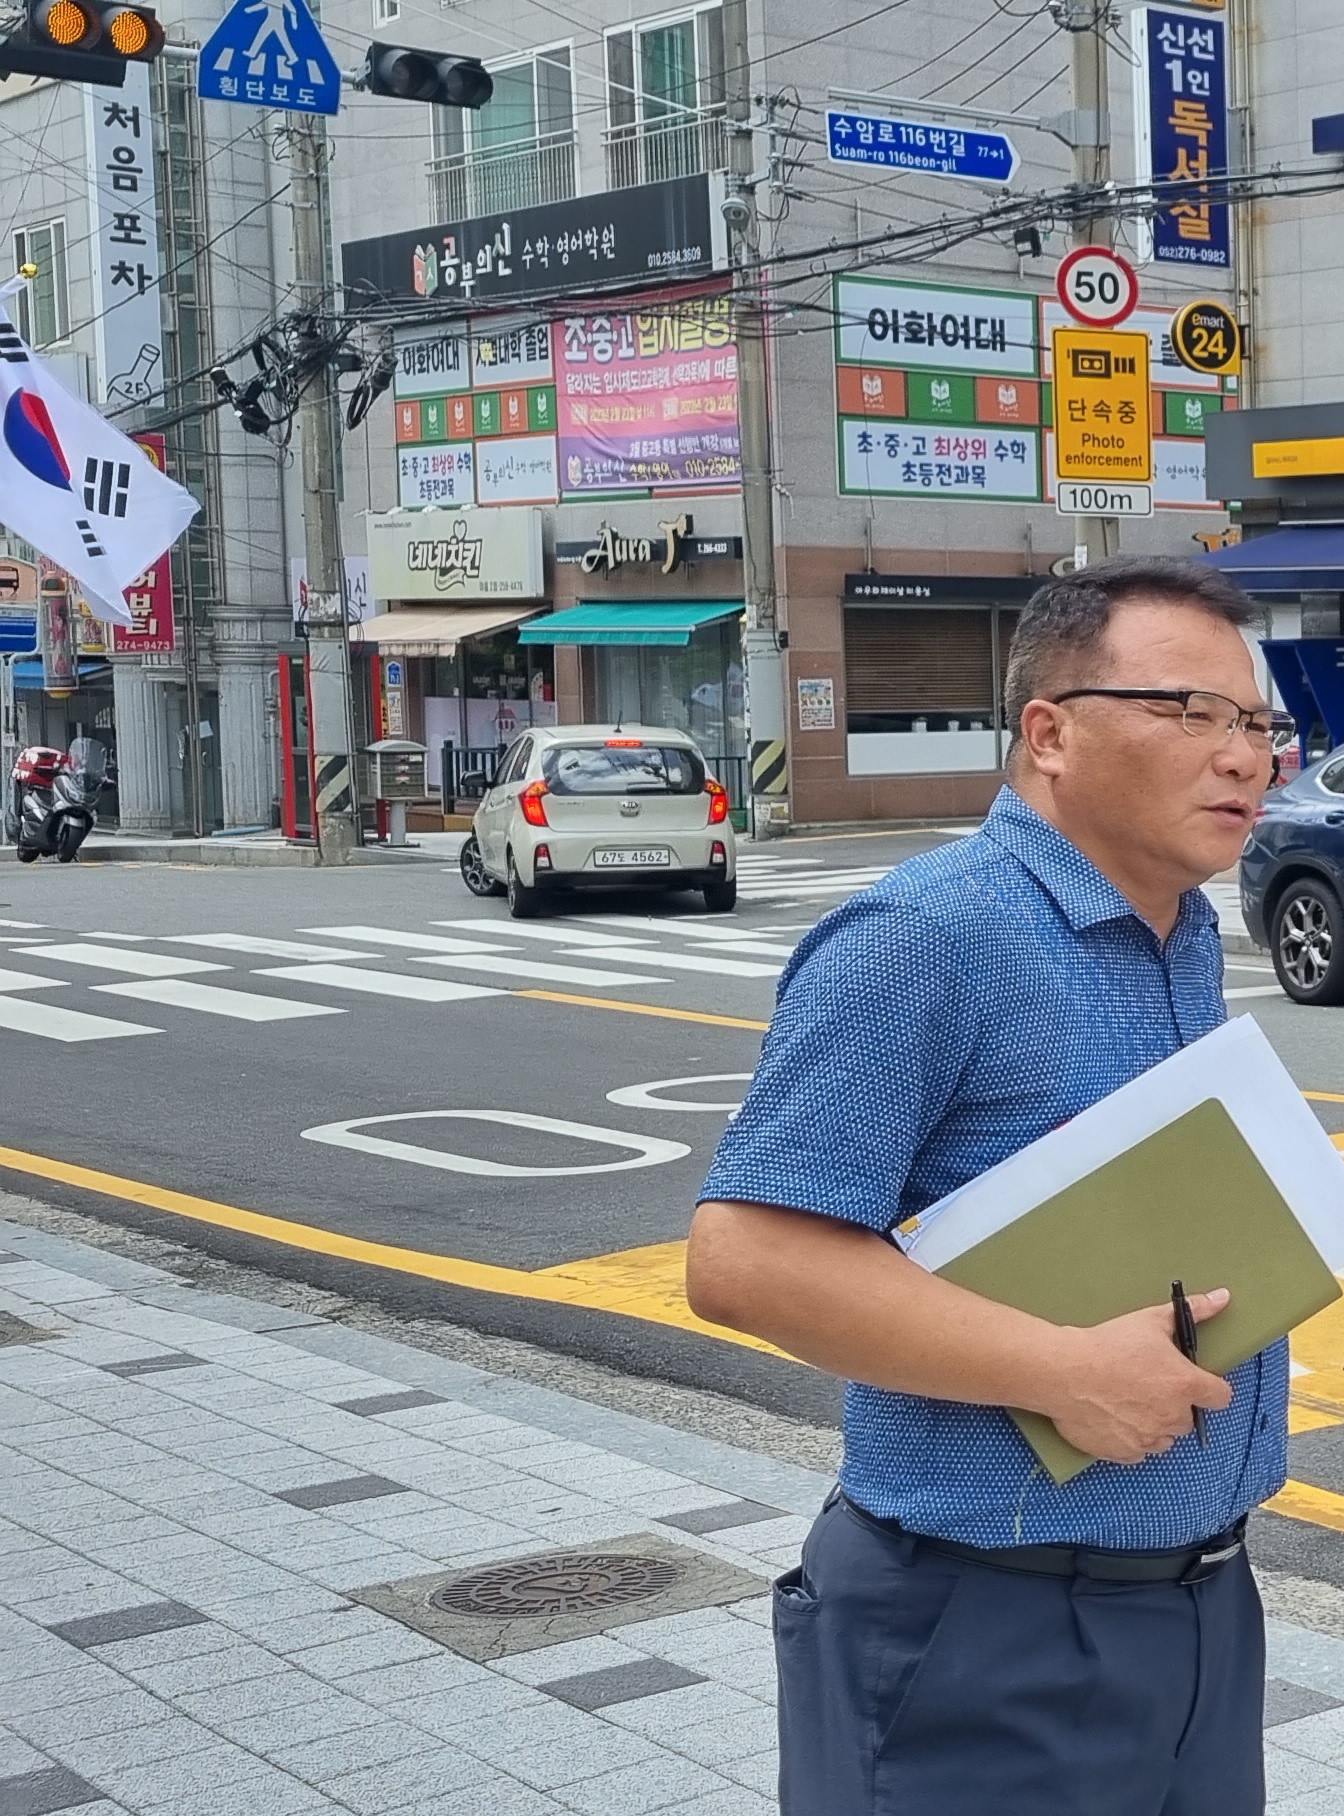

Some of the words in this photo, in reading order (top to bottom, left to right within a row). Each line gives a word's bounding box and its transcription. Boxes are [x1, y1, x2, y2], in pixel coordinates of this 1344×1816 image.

[1157, 22, 1215, 60] 신선
[218, 75, 317, 106] 횡단보도
[1165, 59, 1210, 96] 1인
[834, 143, 885, 162] Suam-ro
[888, 150, 957, 172] 116beon-gil
[1168, 99, 1213, 240] 독서실
[103, 102, 152, 295] 처음포차
[440, 222, 513, 298] 공부의신
[1074, 271, 1120, 304] 50
[868, 307, 1006, 352] 이화여대
[1191, 312, 1225, 328] emart
[402, 337, 460, 376] 이화여대
[1191, 328, 1227, 361] 24
[1067, 397, 1137, 425] 단속중
[857, 431, 927, 459] 초·중·고
[934, 435, 987, 461] 최상위
[994, 439, 1027, 464] 수학
[1081, 432, 1125, 449] Photo
[902, 461, 987, 488] 초등전과목
[1065, 452, 1143, 468] enforcement
[1069, 487, 1133, 510] 100m
[408, 536, 483, 578] 네네치킨
[581, 525, 652, 573] Aura
[631, 851, 663, 863] 4562
